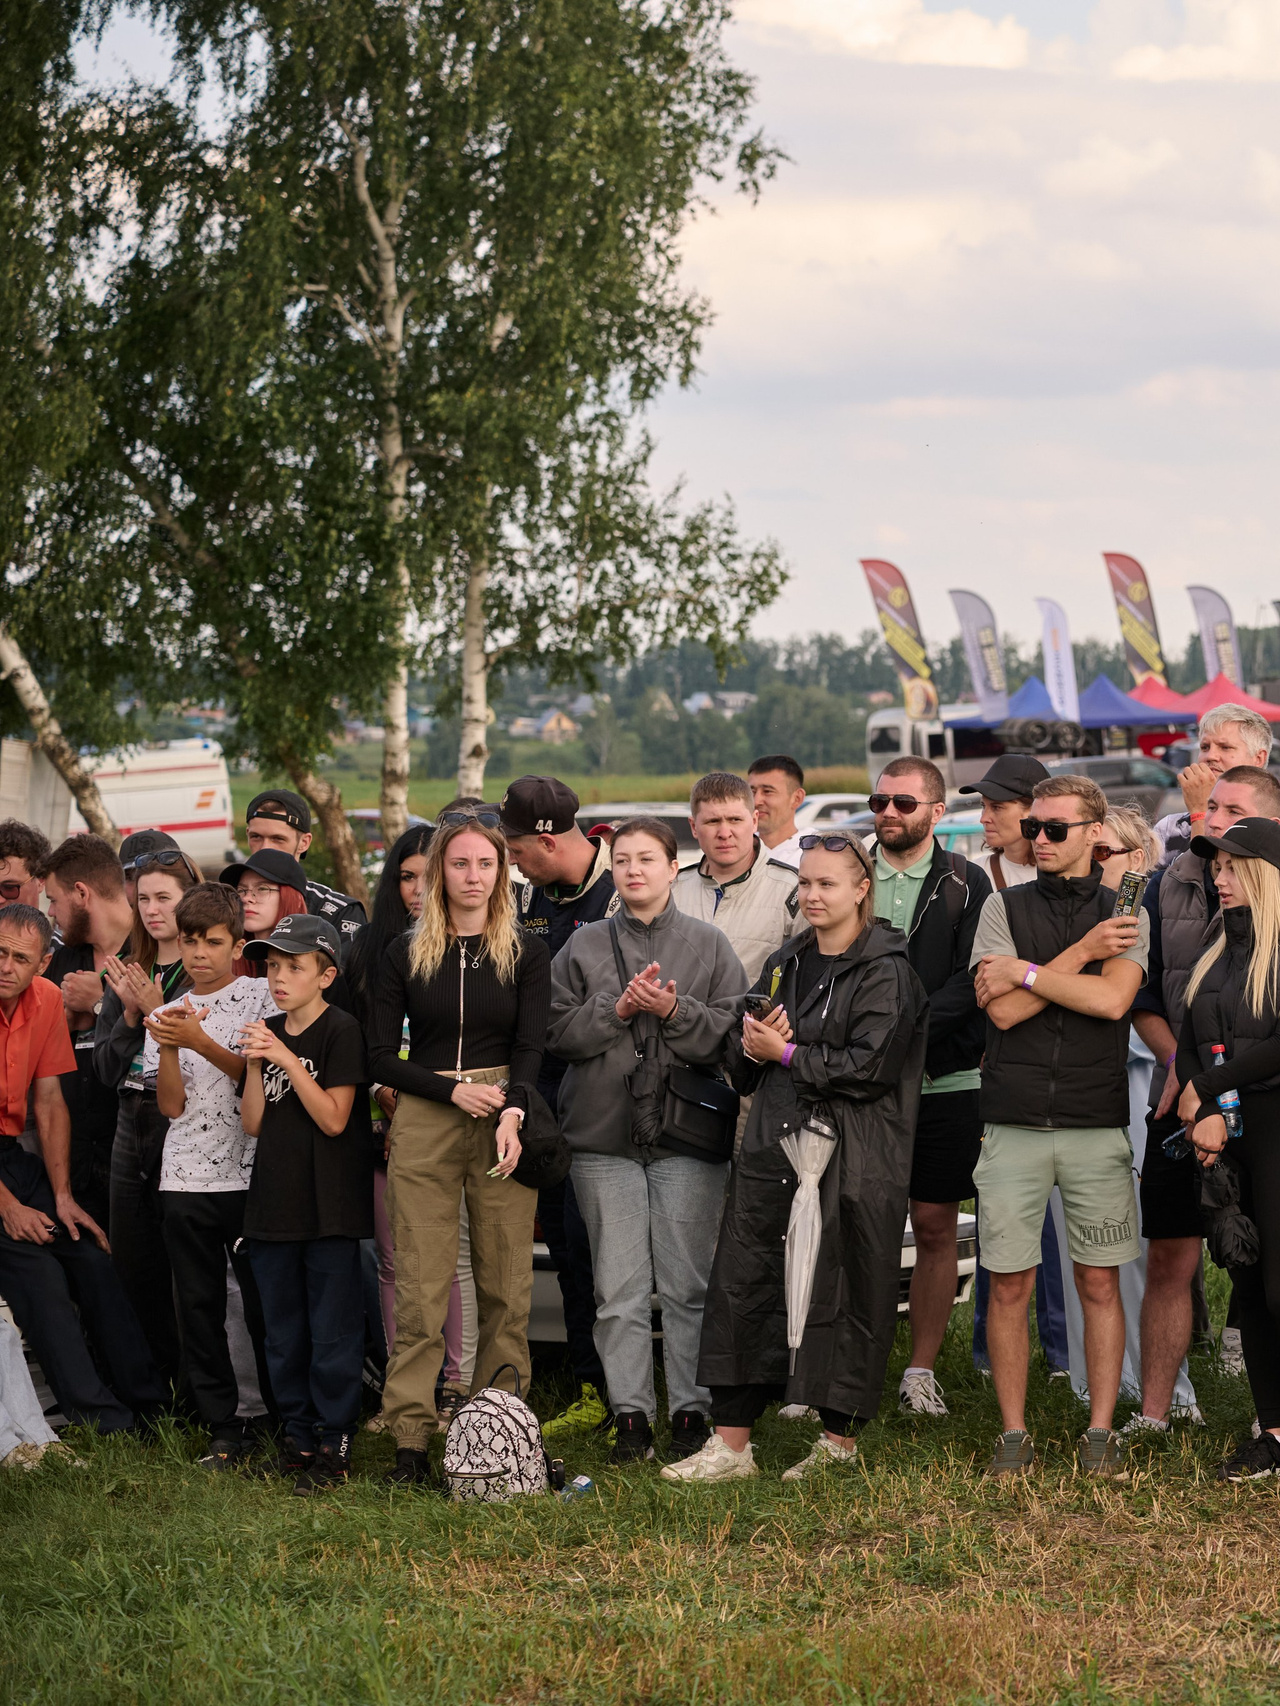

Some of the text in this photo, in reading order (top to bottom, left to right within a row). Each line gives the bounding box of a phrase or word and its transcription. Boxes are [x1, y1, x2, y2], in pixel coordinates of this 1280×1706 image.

[535, 819, 553, 832] 44
[1079, 1221, 1131, 1245] PUMA
[1003, 1429, 1023, 1437] LACOSTE
